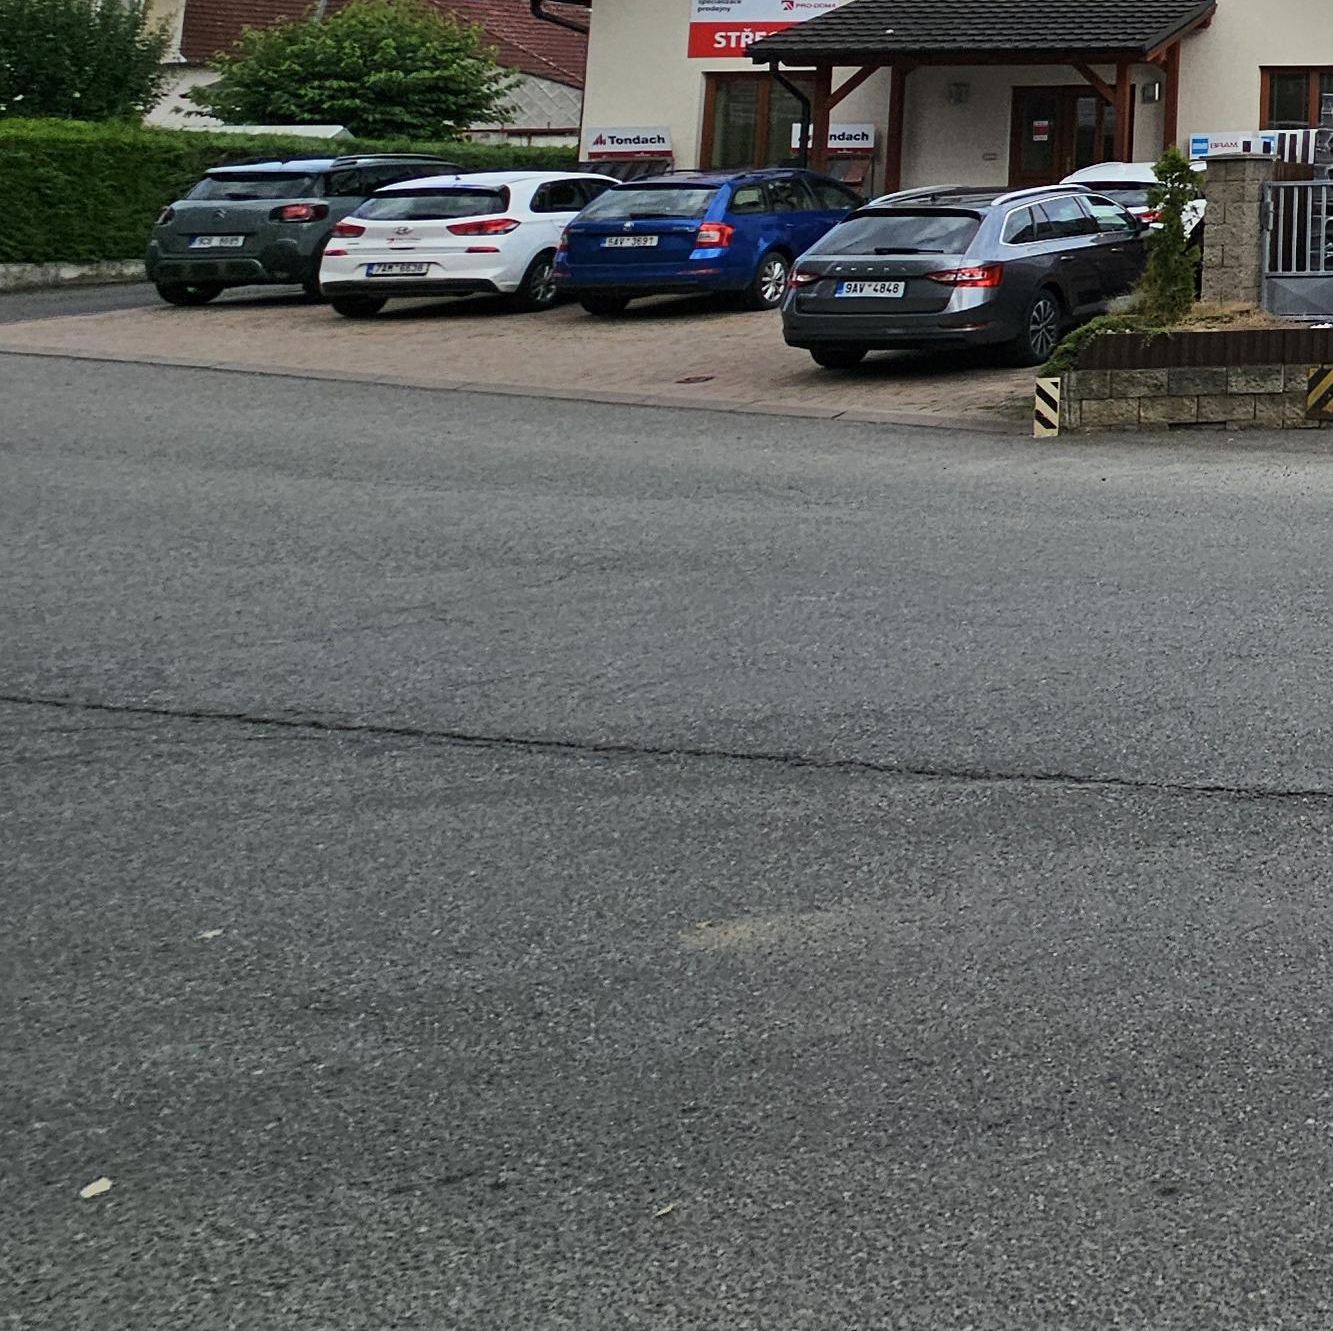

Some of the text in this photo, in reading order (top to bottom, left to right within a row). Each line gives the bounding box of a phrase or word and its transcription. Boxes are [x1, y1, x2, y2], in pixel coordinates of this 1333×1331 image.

[697, 5, 732, 13] prodejny
[713, 28, 778, 48] STŘE
[608, 134, 666, 146] Tondach
[828, 131, 870, 142] ndach
[845, 283, 900, 294] 9AV 4848
